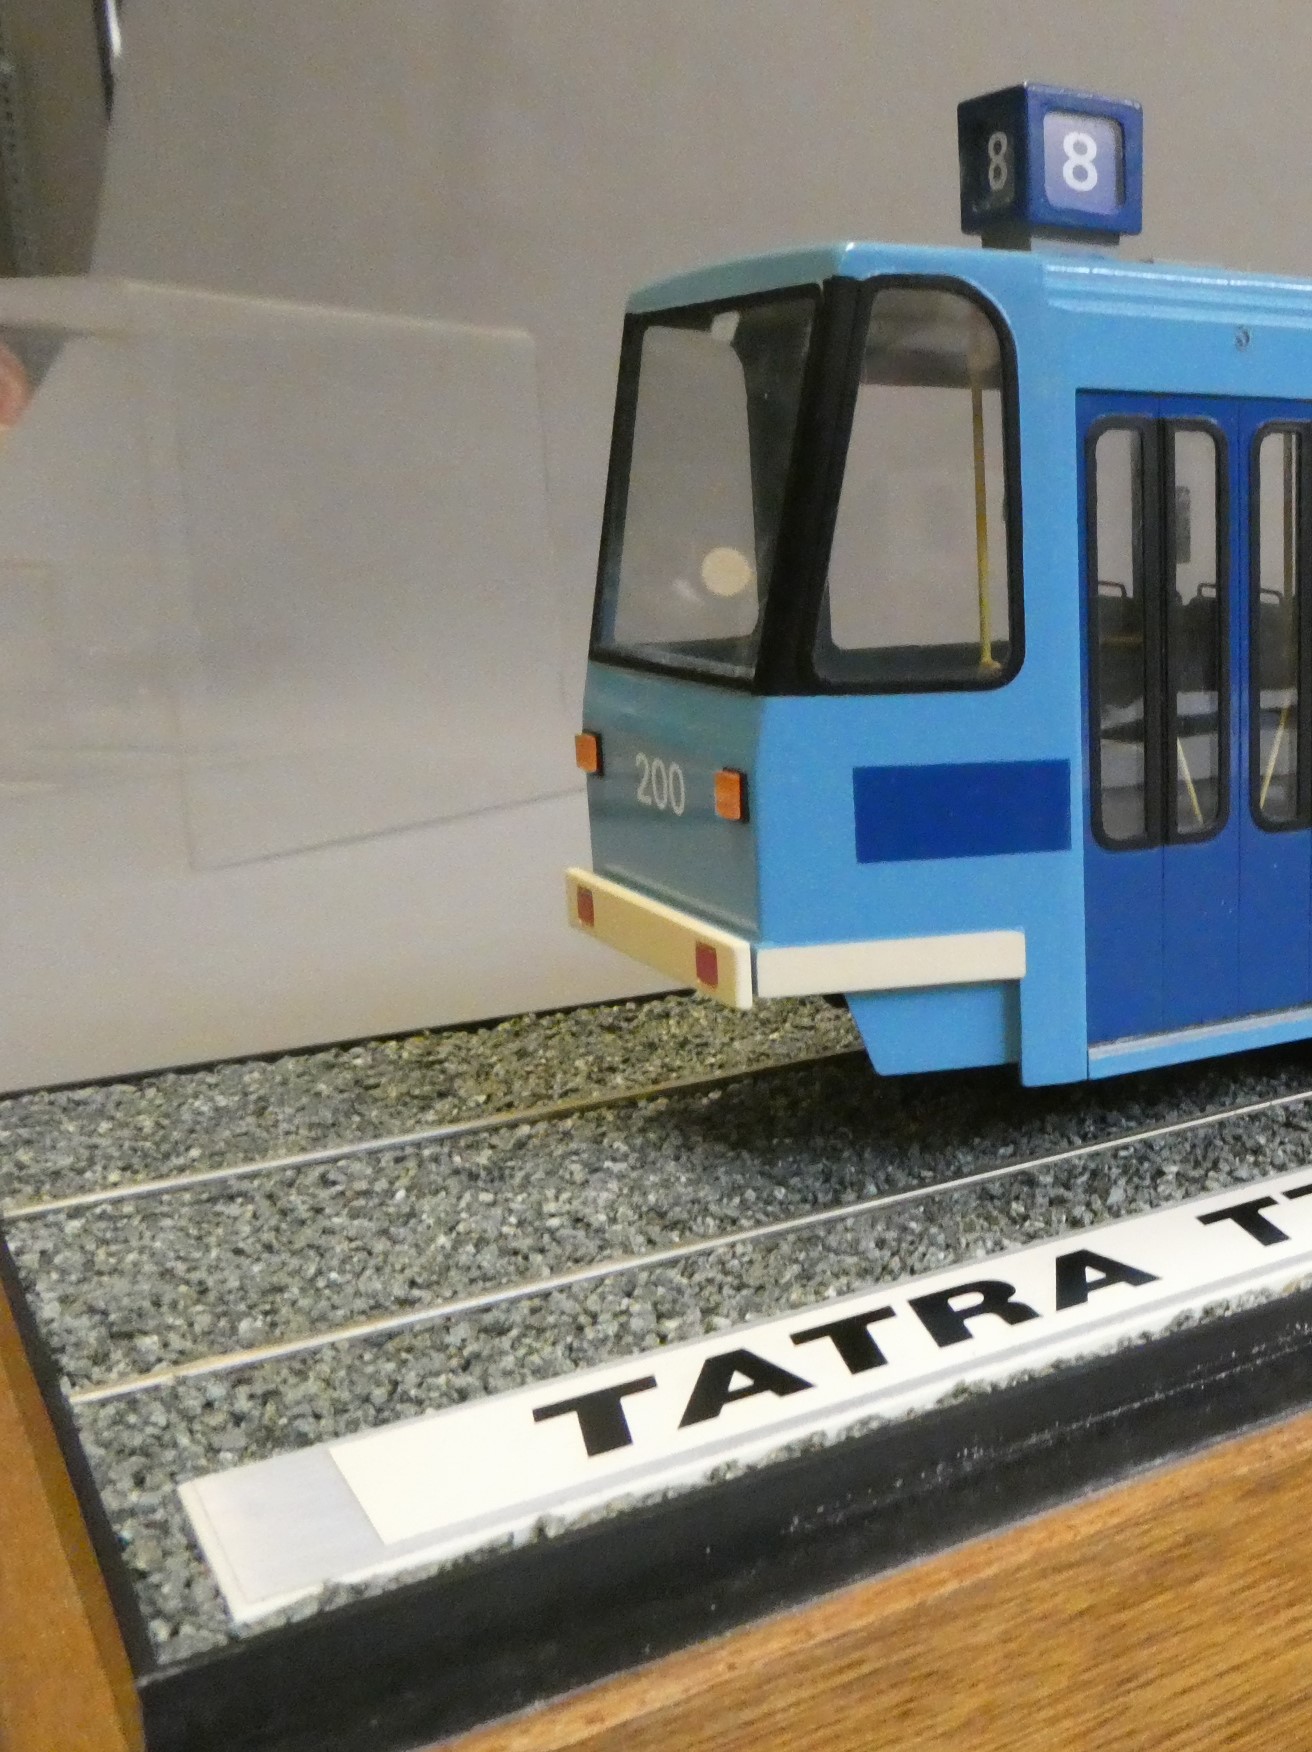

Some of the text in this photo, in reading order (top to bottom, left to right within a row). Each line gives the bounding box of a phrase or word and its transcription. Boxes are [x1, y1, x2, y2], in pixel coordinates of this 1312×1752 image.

[988, 131, 1008, 192] 8
[1062, 131, 1098, 193] 8
[635, 752, 686, 817] 200
[532, 1247, 1163, 1458] TATRA
